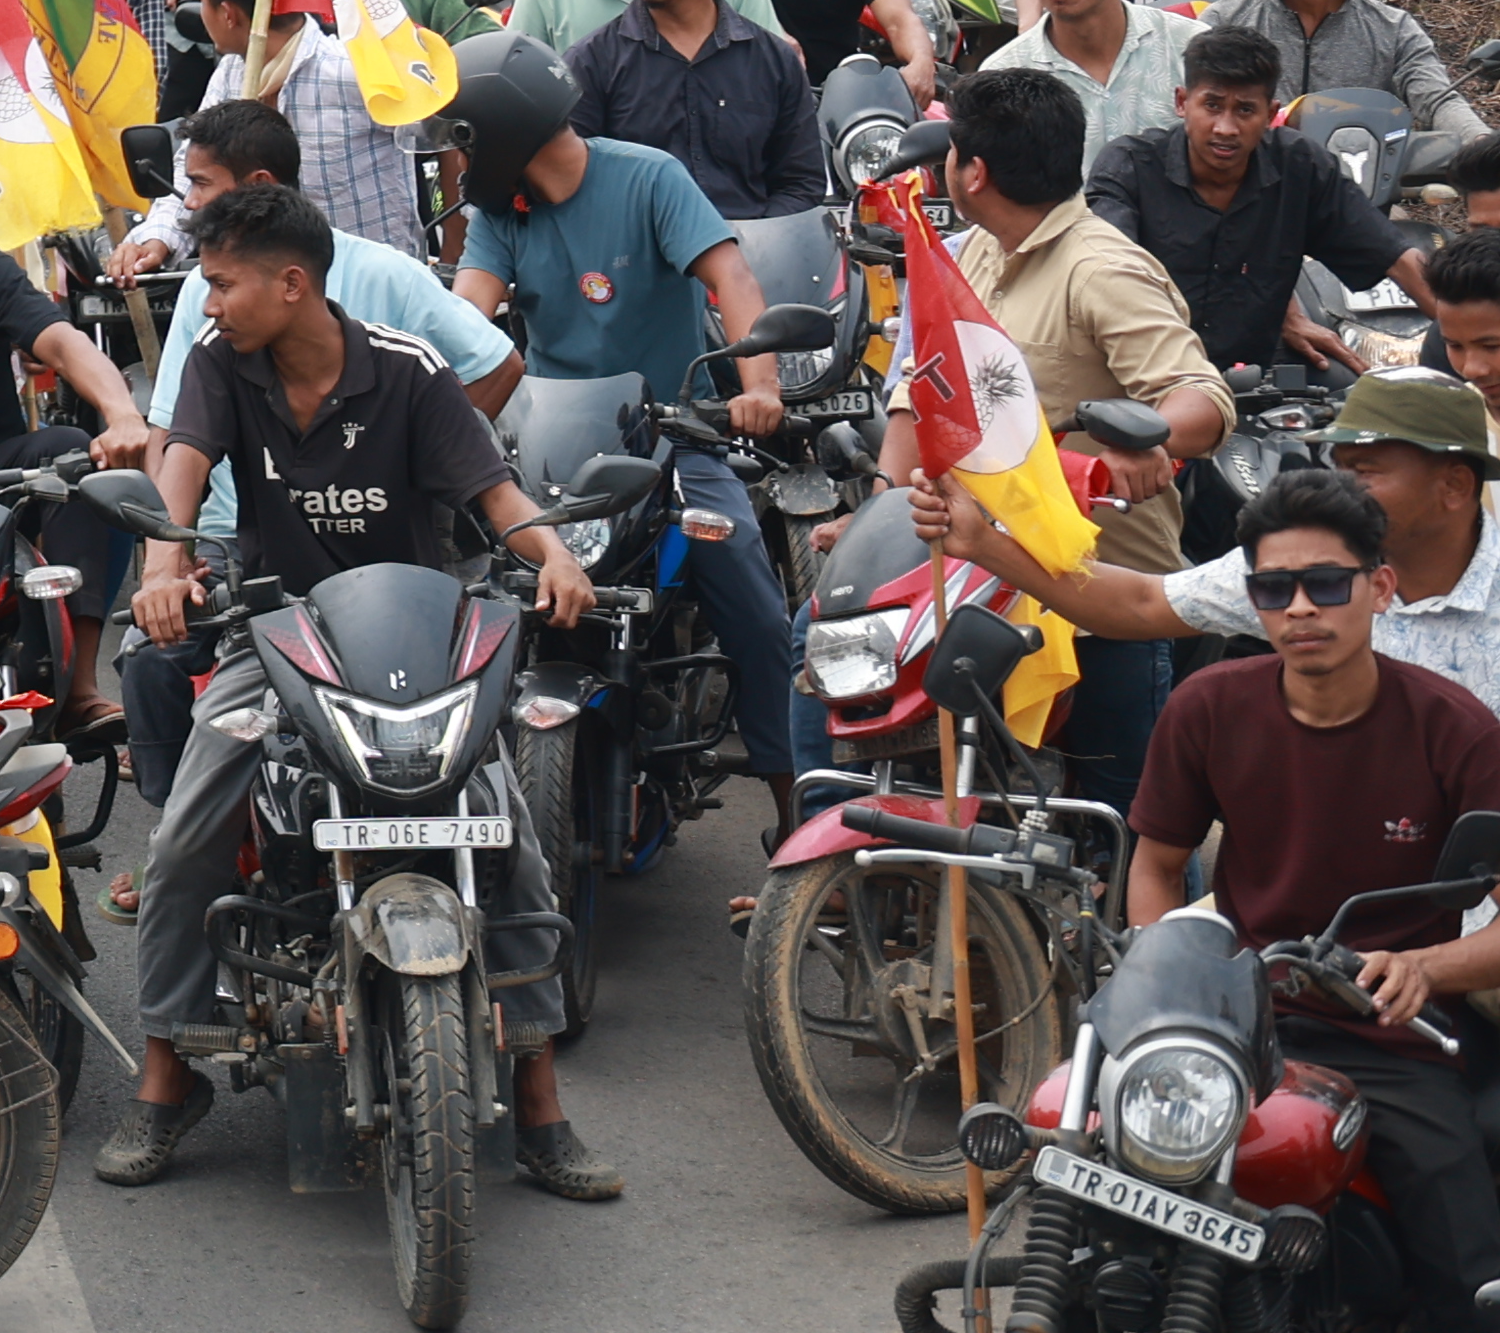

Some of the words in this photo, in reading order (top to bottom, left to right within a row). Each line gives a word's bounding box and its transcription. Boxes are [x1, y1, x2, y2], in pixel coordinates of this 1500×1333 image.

[819, 392, 864, 414] 6026
[340, 820, 369, 847] TR
[388, 820, 430, 846] 06E
[449, 819, 506, 845] 7490
[1067, 1165, 1102, 1195] TR
[1108, 1181, 1177, 1230] 01AY
